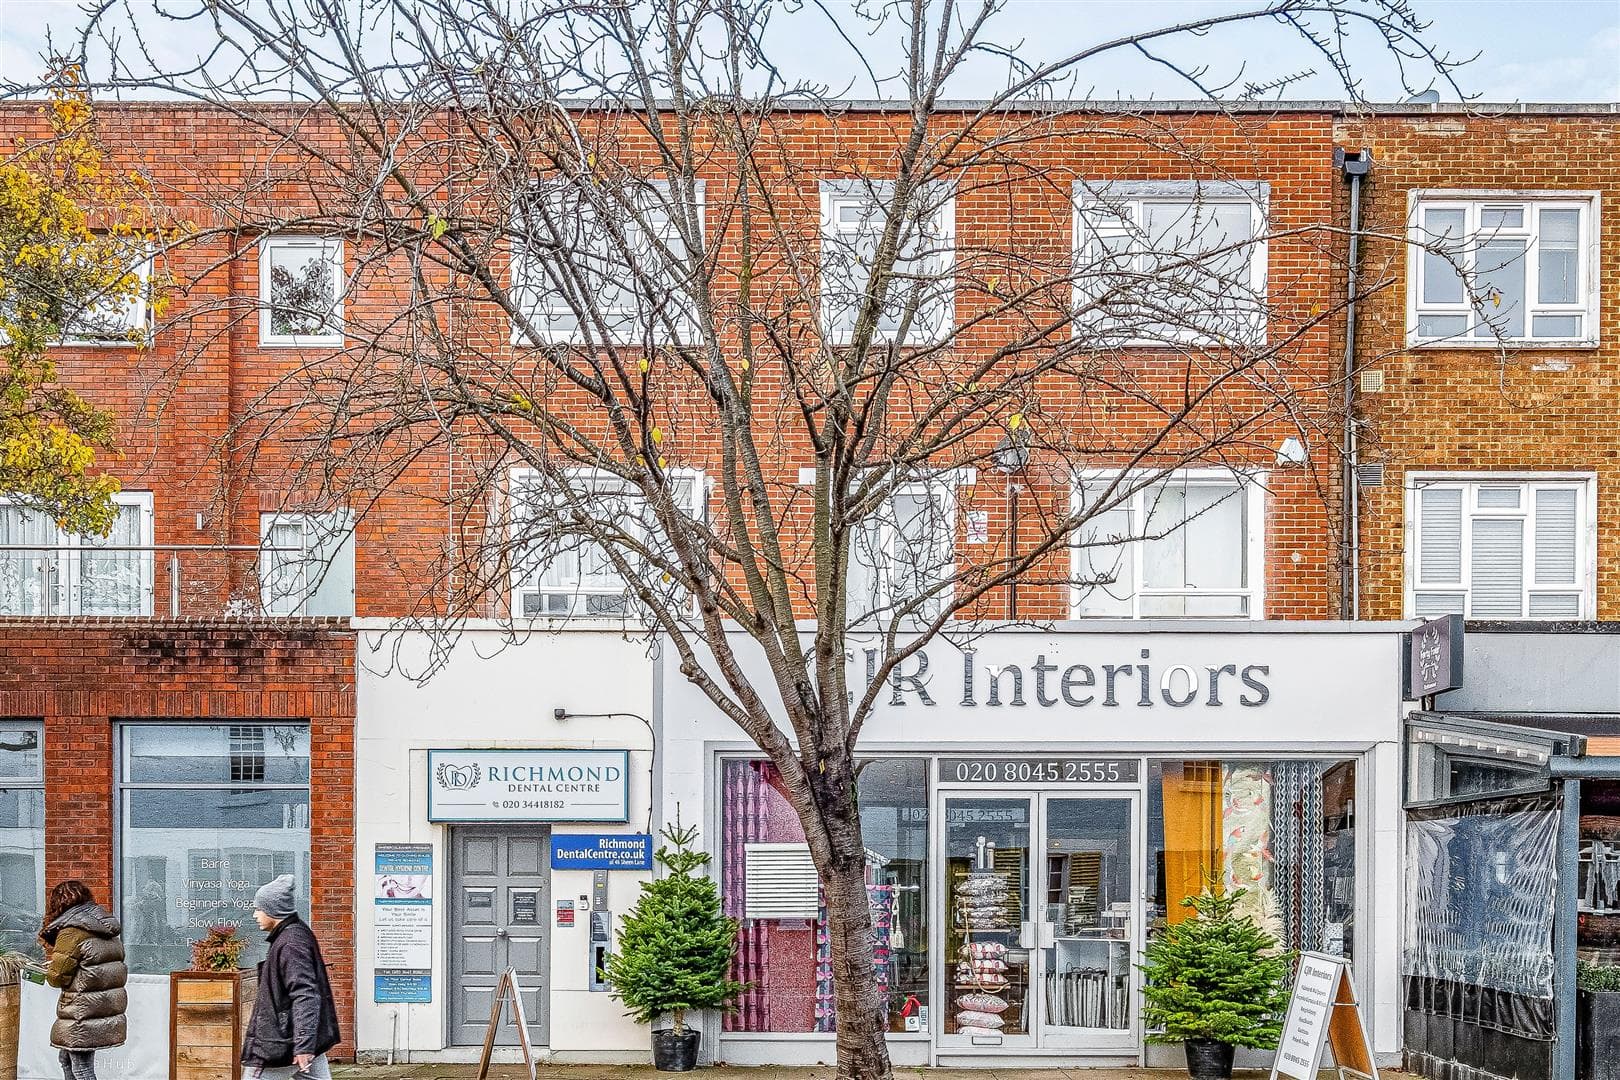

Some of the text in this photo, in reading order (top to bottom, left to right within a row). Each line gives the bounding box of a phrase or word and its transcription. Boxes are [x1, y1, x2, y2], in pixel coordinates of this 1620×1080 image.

[959, 648, 1270, 708] Interiors
[488, 766, 621, 782] RICHMOND
[956, 762, 1120, 782] 020 8045 2555
[508, 784, 600, 793] DENTAL CENTRE
[502, 800, 565, 809] 020 34418182
[599, 838, 645, 849] Richmond
[557, 848, 645, 859] DentalCentre.co.uk
[201, 858, 230, 869] Barre
[182, 879, 250, 891] Vinyasa Yoga
[175, 898, 255, 910] Beginners Yoga
[189, 917, 243, 928] Slow Flow
